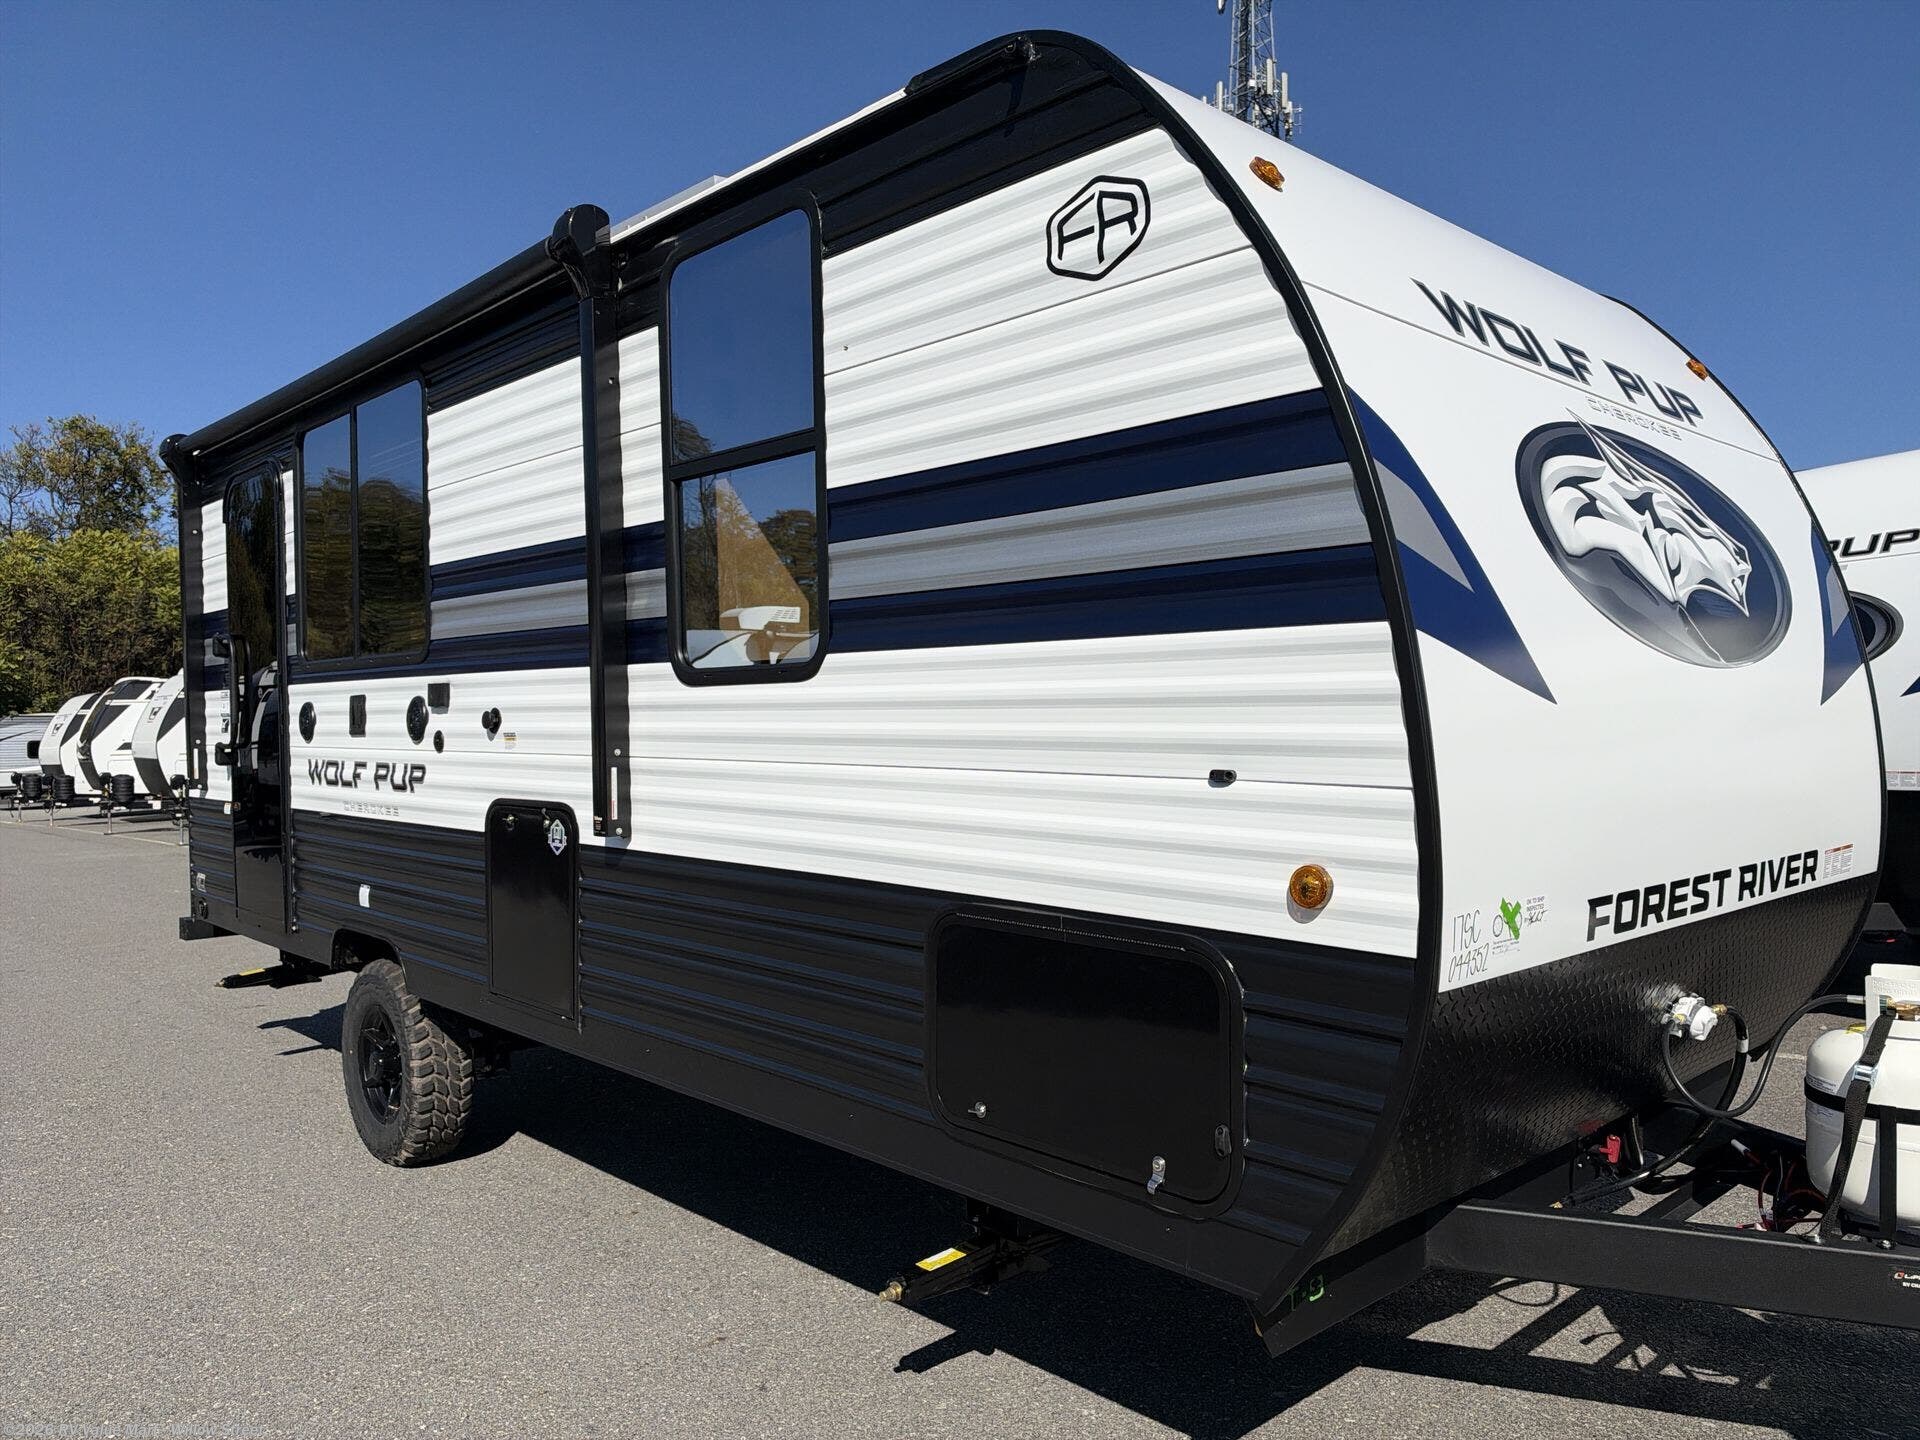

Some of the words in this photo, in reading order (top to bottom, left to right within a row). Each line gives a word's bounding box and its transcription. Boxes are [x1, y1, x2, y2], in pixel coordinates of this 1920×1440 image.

[1410, 277, 1594, 385] WOLF
[1602, 358, 1704, 427] PUP
[1585, 395, 1683, 441] CHEROKEE
[308, 759, 367, 788] WOLF
[374, 762, 427, 793] PUP
[1586, 869, 1732, 942] FOREST
[1738, 849, 1819, 903] RIVER
